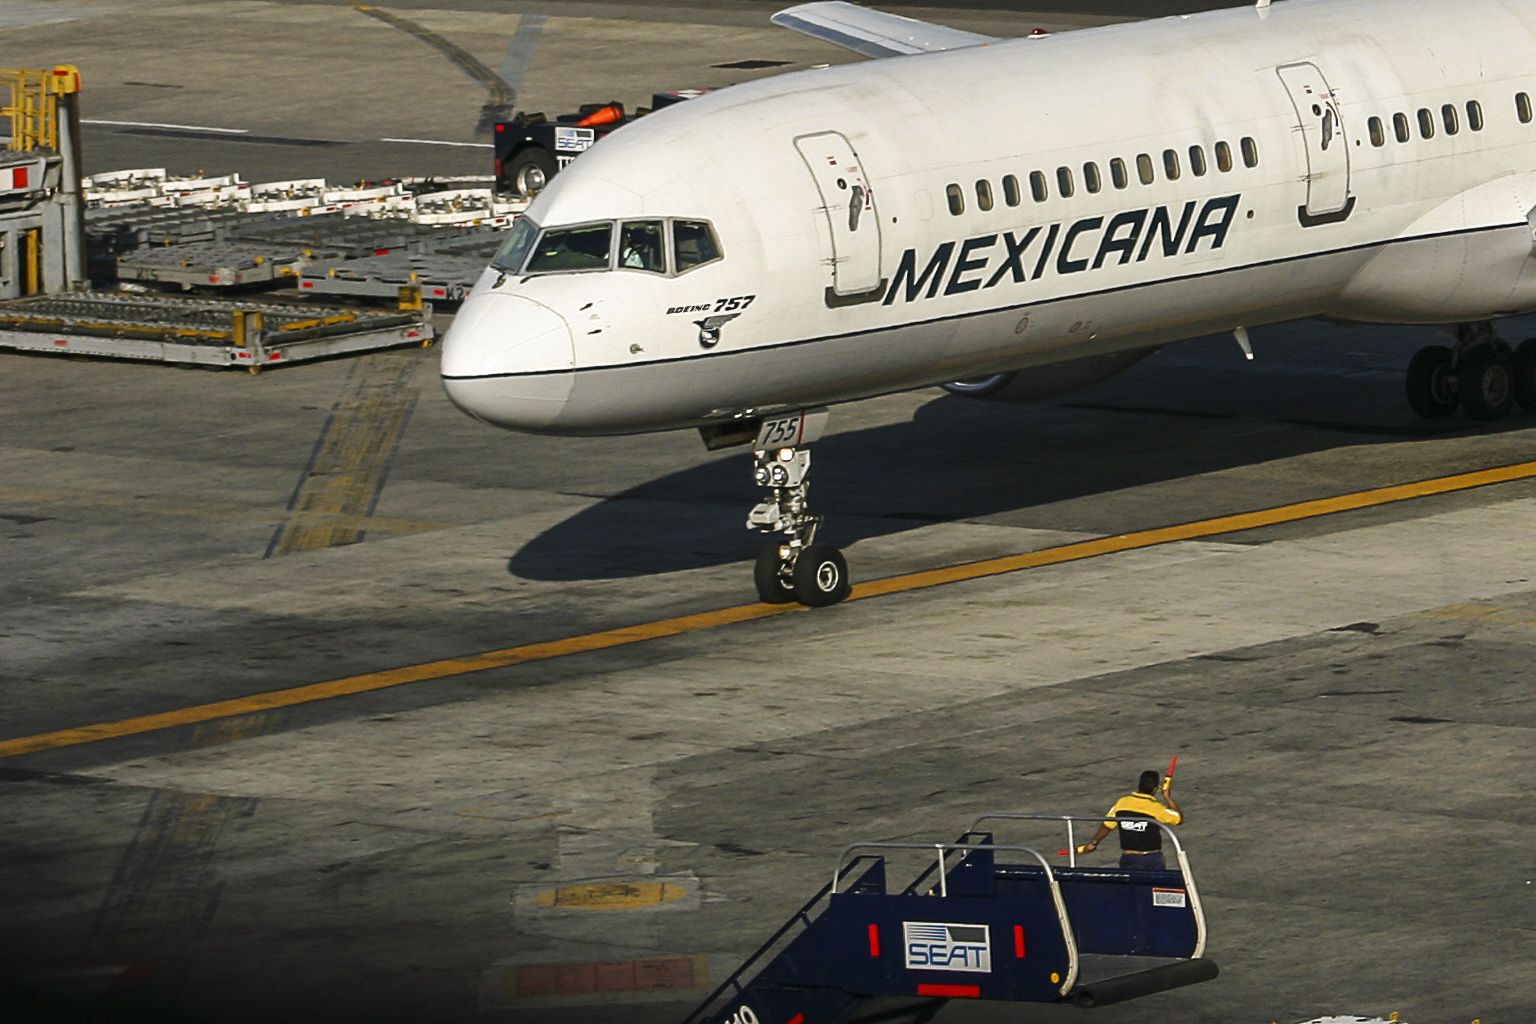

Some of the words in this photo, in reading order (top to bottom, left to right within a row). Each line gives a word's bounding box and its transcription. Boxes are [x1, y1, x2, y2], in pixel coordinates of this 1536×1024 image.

[881, 193, 1241, 306] MEXICANA
[666, 303, 711, 314] BOEING
[713, 295, 757, 313] 757
[762, 417, 800, 445] 755
[909, 943, 987, 968] SEAT
